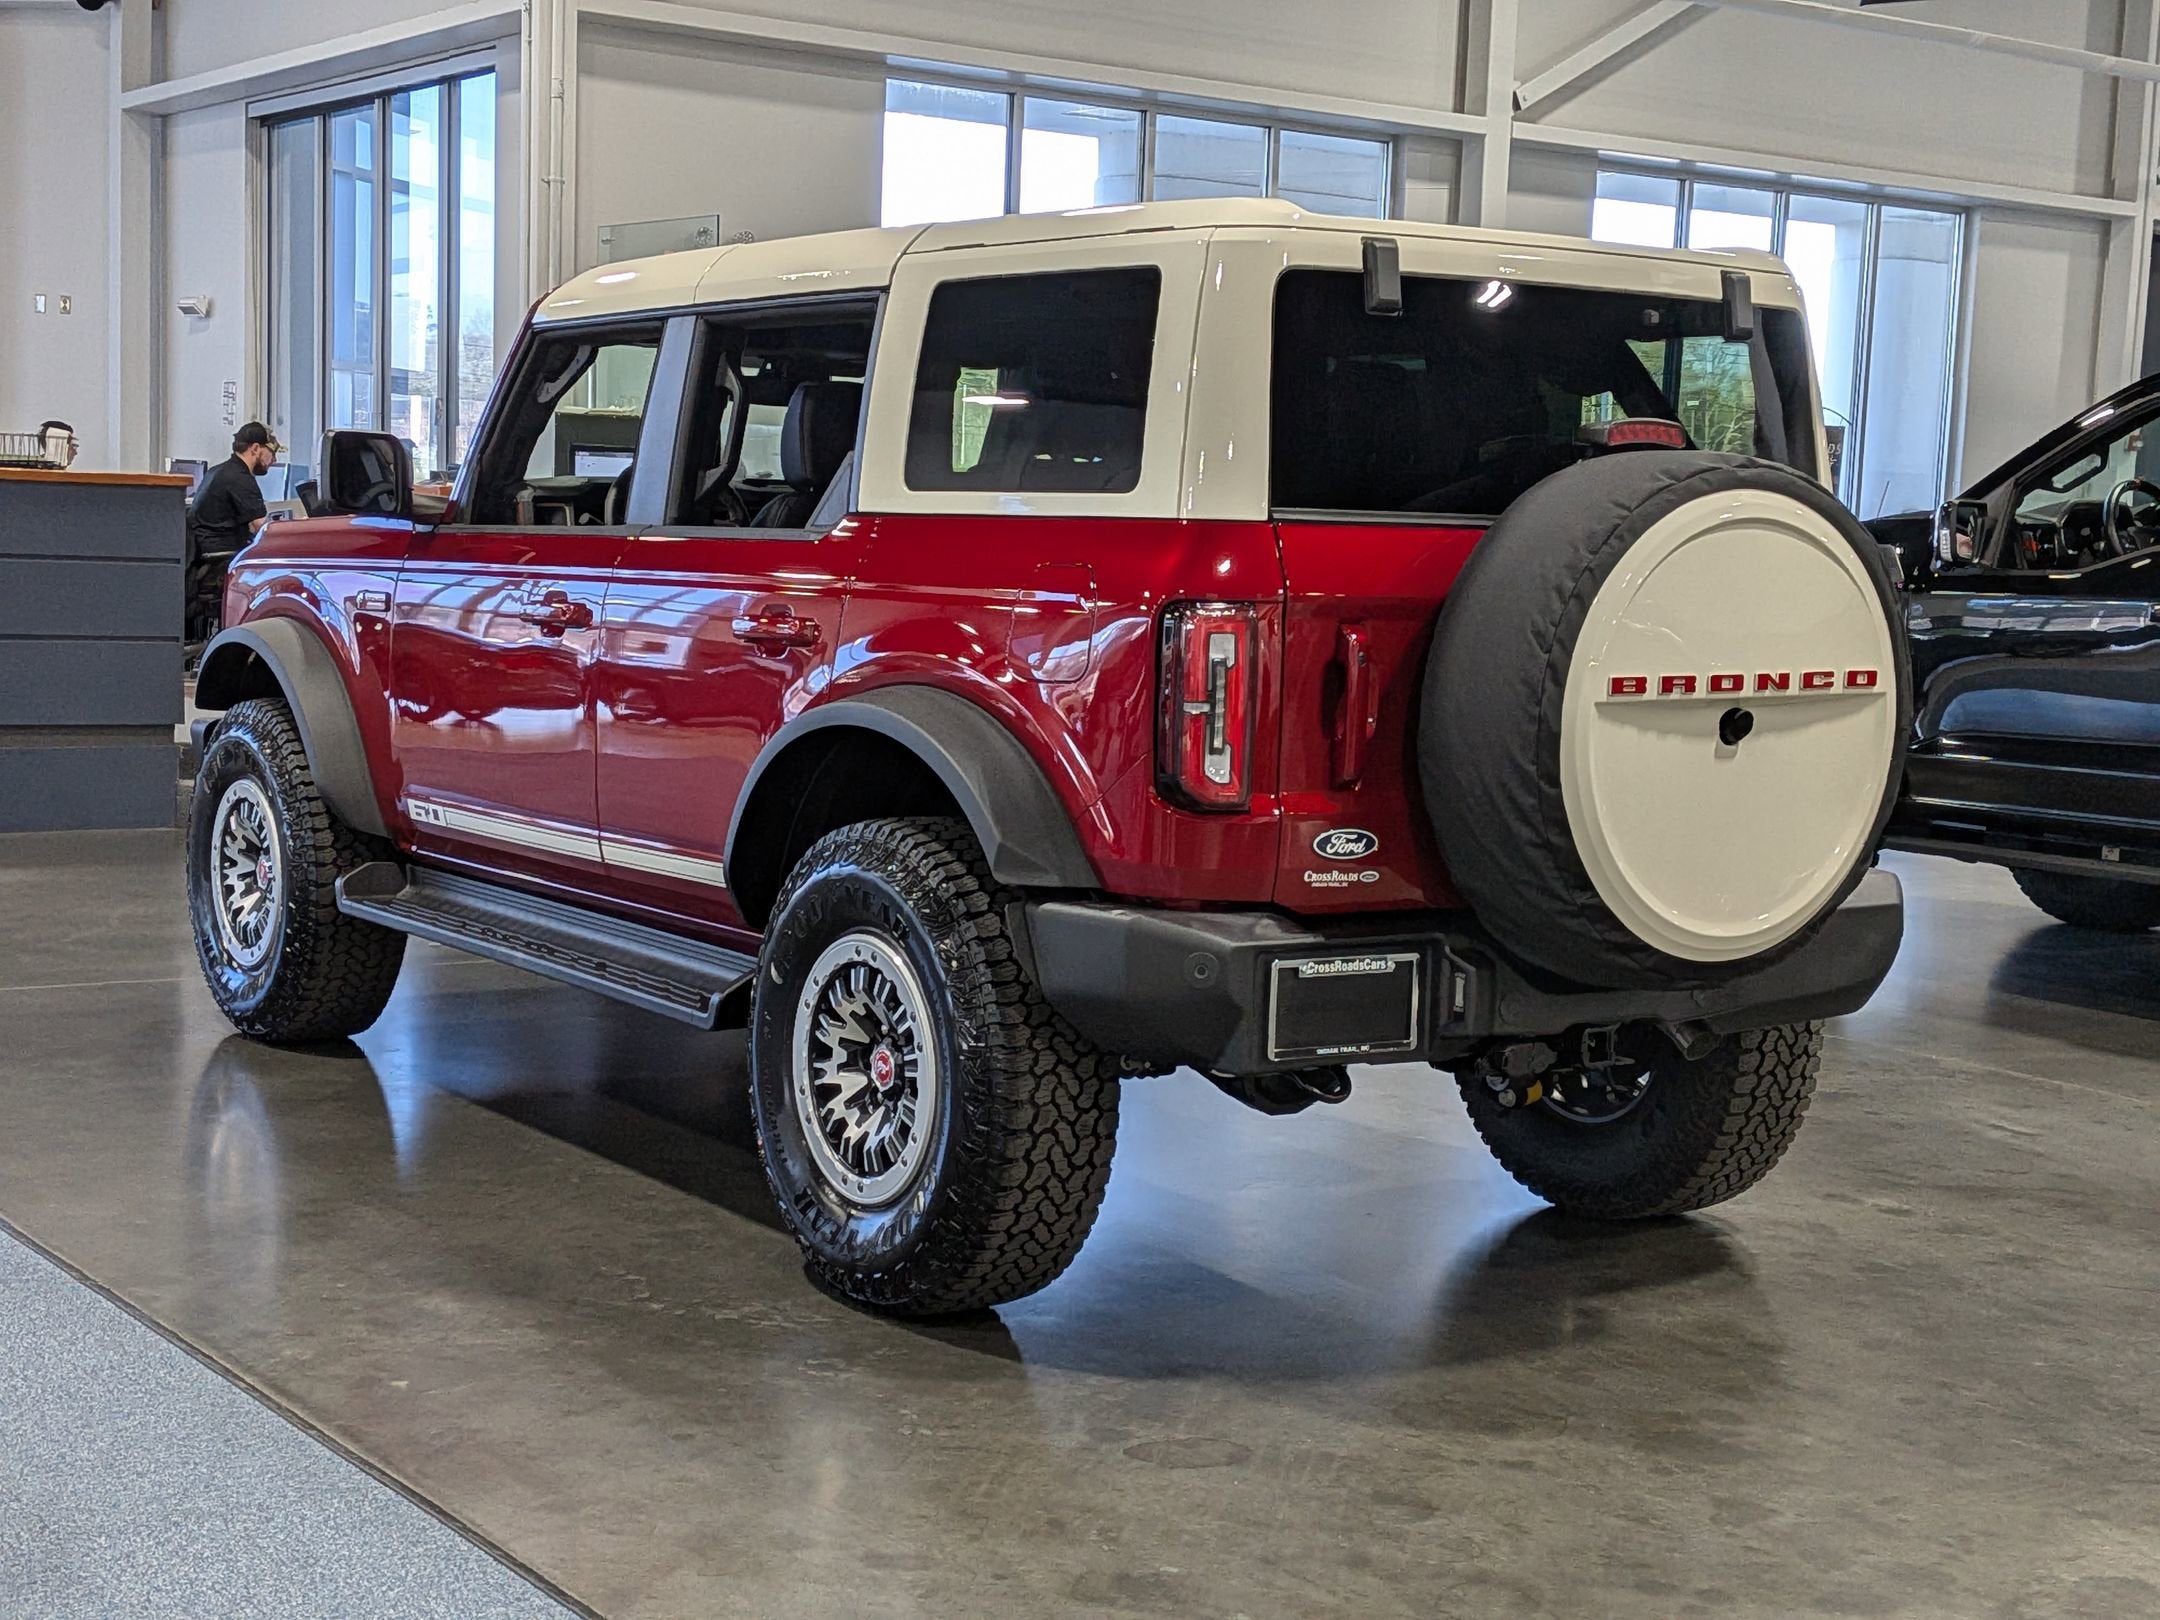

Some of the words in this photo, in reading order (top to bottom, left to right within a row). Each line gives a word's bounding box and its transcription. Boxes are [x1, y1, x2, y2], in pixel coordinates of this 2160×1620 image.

[1608, 670, 1878, 695] BRONCO
[1324, 832, 1368, 855] Ford
[1306, 957, 1387, 974] CrossRoadsCars
